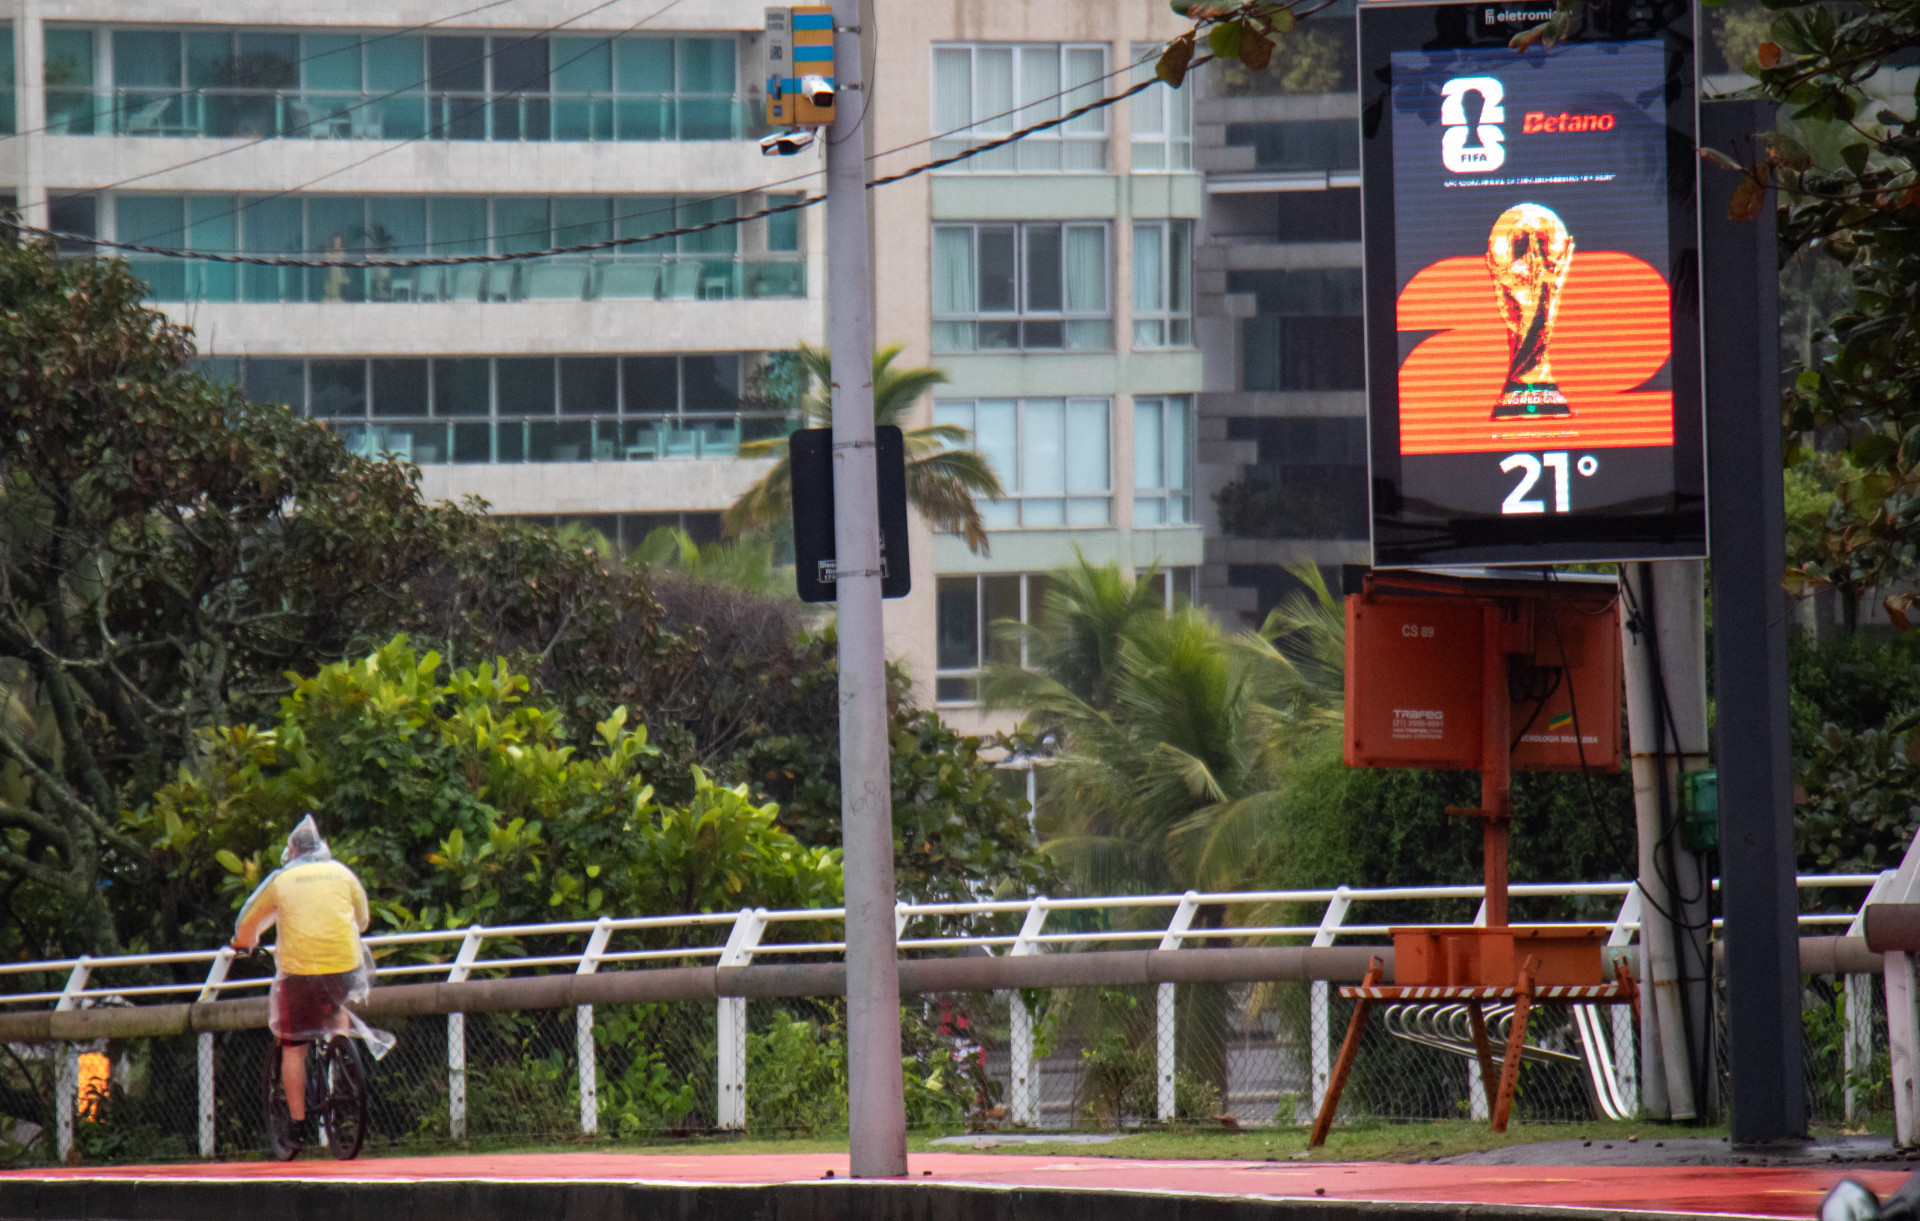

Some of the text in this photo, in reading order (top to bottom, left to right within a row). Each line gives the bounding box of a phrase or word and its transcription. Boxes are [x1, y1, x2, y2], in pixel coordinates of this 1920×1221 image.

[1496, 8, 1572, 22] eletromi
[1522, 111, 1616, 134] Betano
[1461, 153, 1487, 163] FIFA
[1500, 452, 1598, 514] 21°
[1402, 624, 1434, 638] CS 89
[1519, 734, 1598, 744] ECNOLOGIA BRASEIRA
